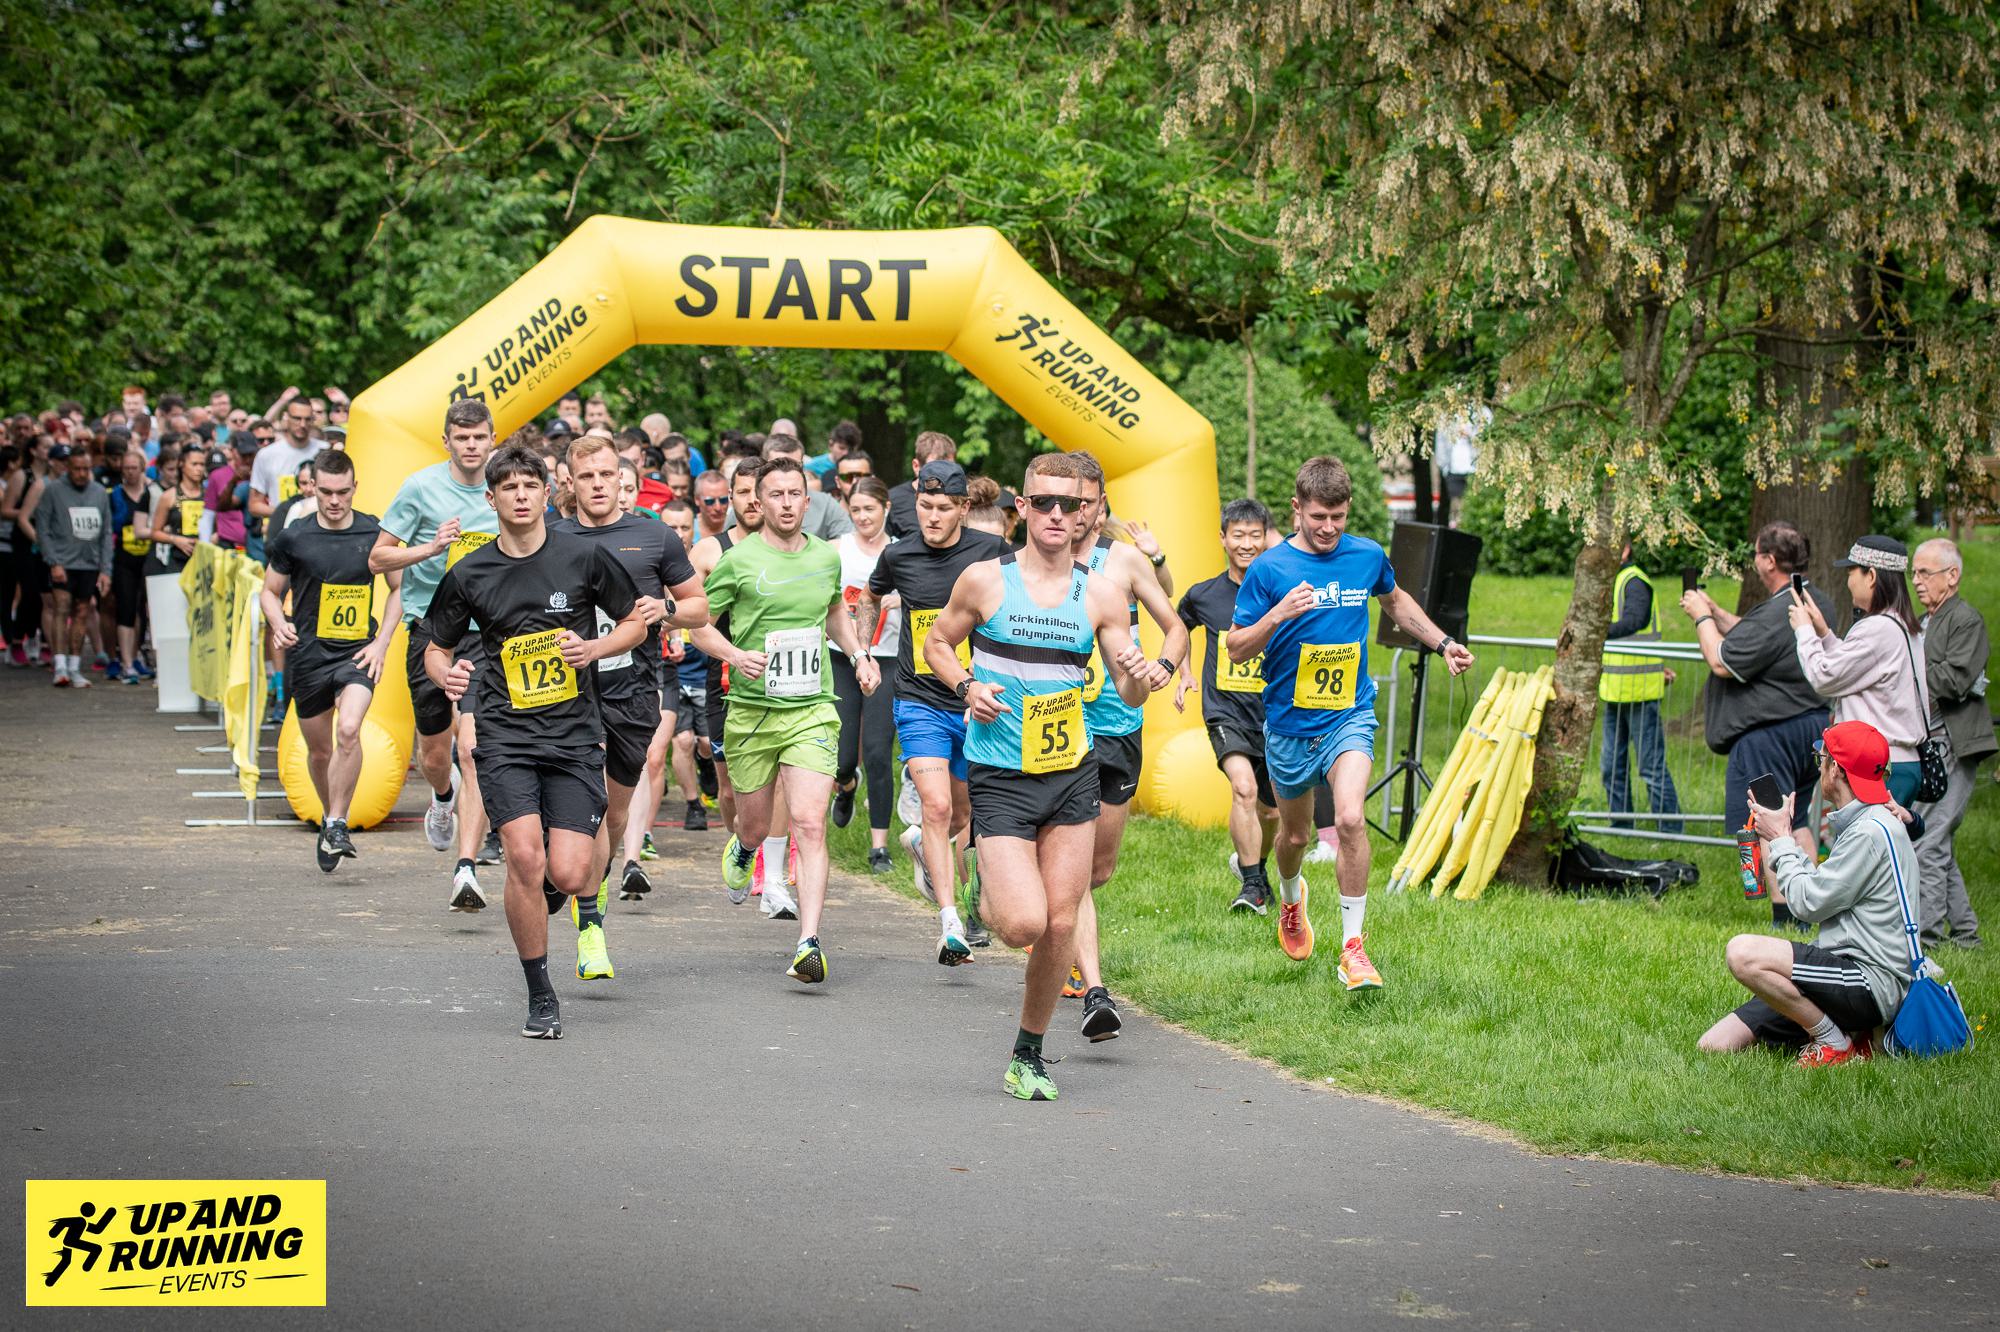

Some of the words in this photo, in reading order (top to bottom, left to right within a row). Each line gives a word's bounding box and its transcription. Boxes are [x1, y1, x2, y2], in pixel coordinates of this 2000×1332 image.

[674, 255, 927, 321] START
[483, 338, 515, 372] UP
[511, 297, 562, 342] AND
[489, 305, 588, 400] RUNNING
[527, 347, 572, 391] EVENTS
[1059, 337, 1093, 370] UP
[1083, 366, 1141, 404] AND
[1033, 347, 1140, 430] RUNNING
[1045, 383, 1097, 424] EVENTS
[1090, 555, 1099, 571] oar
[1072, 581, 1083, 602] soar
[332, 605, 357, 627] 60
[1009, 614, 1080, 630] Kirkintilloch
[525, 639, 537, 648] UP
[538, 633, 556, 644] AND
[1012, 628, 1076, 643] Olympians
[769, 648, 820, 676] 4116
[1320, 653, 1356, 663] RUNNING
[1336, 647, 1353, 655] AND
[520, 656, 567, 691] 123
[1315, 667, 1344, 695] 98
[522, 690, 549, 698] Alexandra
[1046, 698, 1057, 707] UP
[1057, 693, 1073, 704] AND
[1042, 700, 1076, 716] RUNNING
[1041, 720, 1069, 755] 55
[1034, 754, 1060, 763] Alexandra
